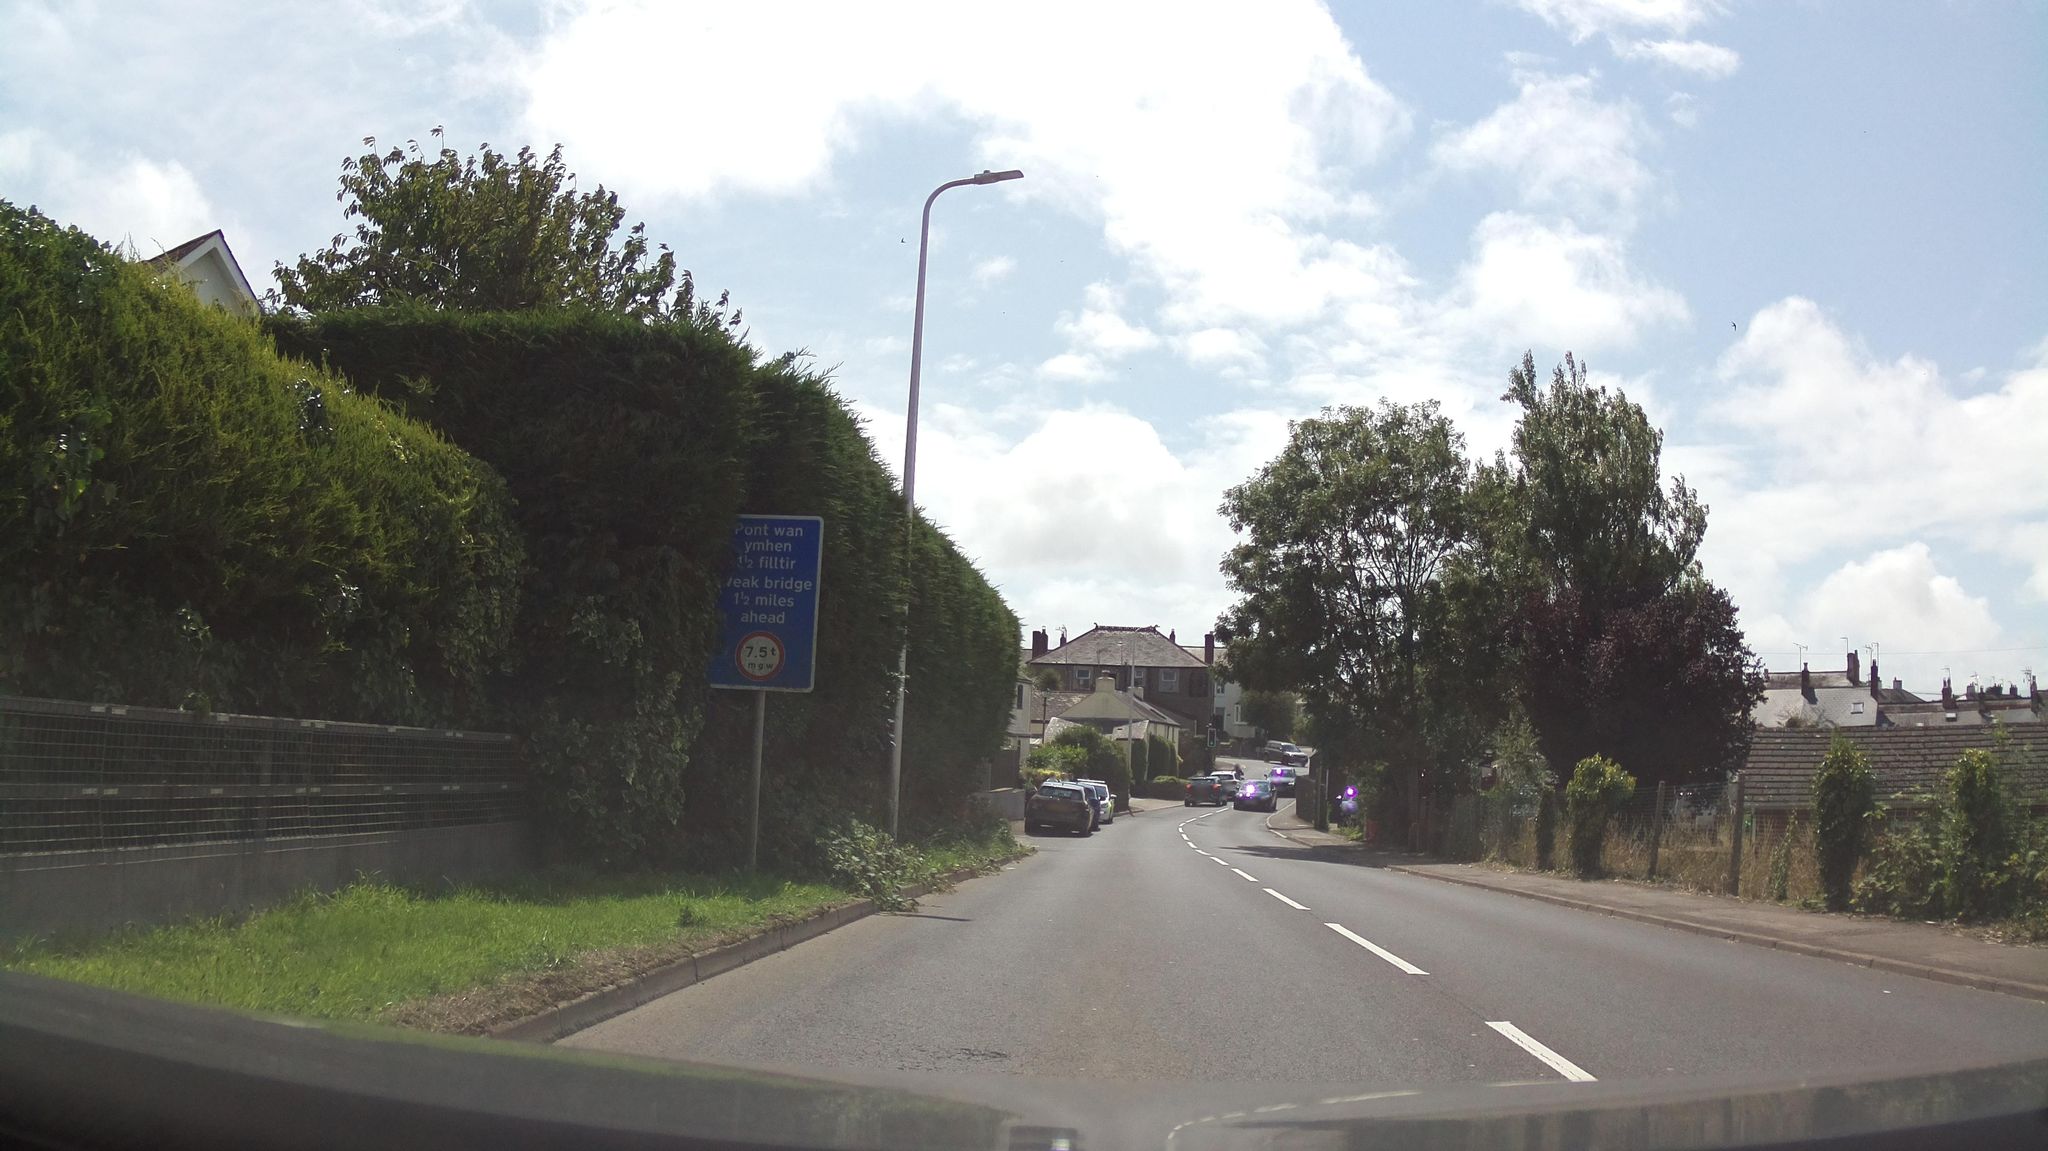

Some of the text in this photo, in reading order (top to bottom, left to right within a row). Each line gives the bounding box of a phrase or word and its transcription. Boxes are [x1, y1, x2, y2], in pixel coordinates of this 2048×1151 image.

[735, 524, 803, 537] Pont wan
[745, 540, 792, 553] ymhen
[759, 556, 796, 569] filltir
[765, 577, 812, 592] bridge
[755, 594, 794, 607] miles
[741, 612, 785, 624] ahead
